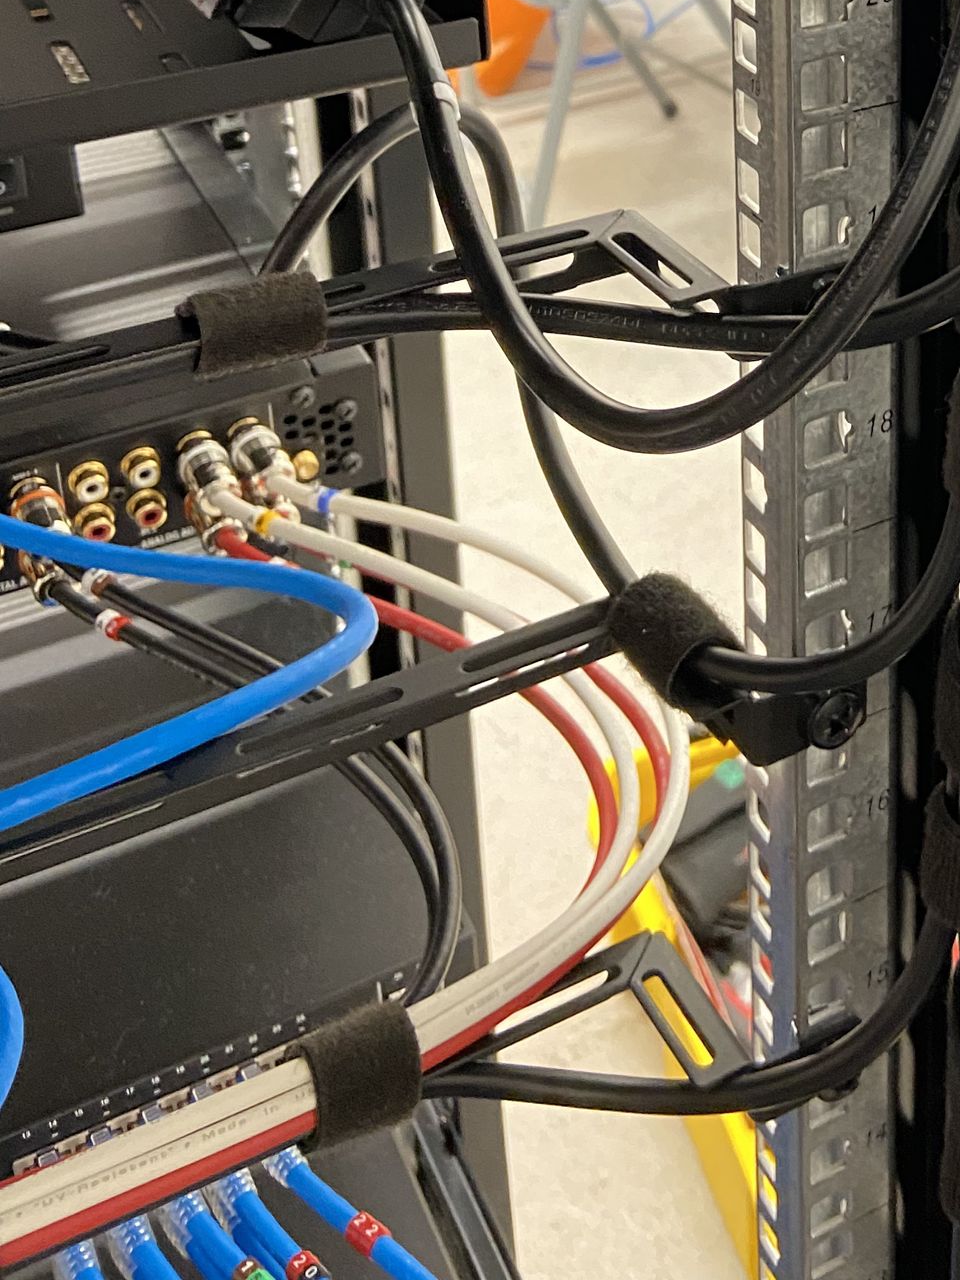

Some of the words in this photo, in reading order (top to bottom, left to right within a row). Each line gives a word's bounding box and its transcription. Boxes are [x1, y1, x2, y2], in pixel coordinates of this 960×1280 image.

[866, 409, 894, 439] 18
[865, 788, 891, 821] 16
[353, 1213, 380, 1238] 22
[292, 1255, 319, 1279] 20
